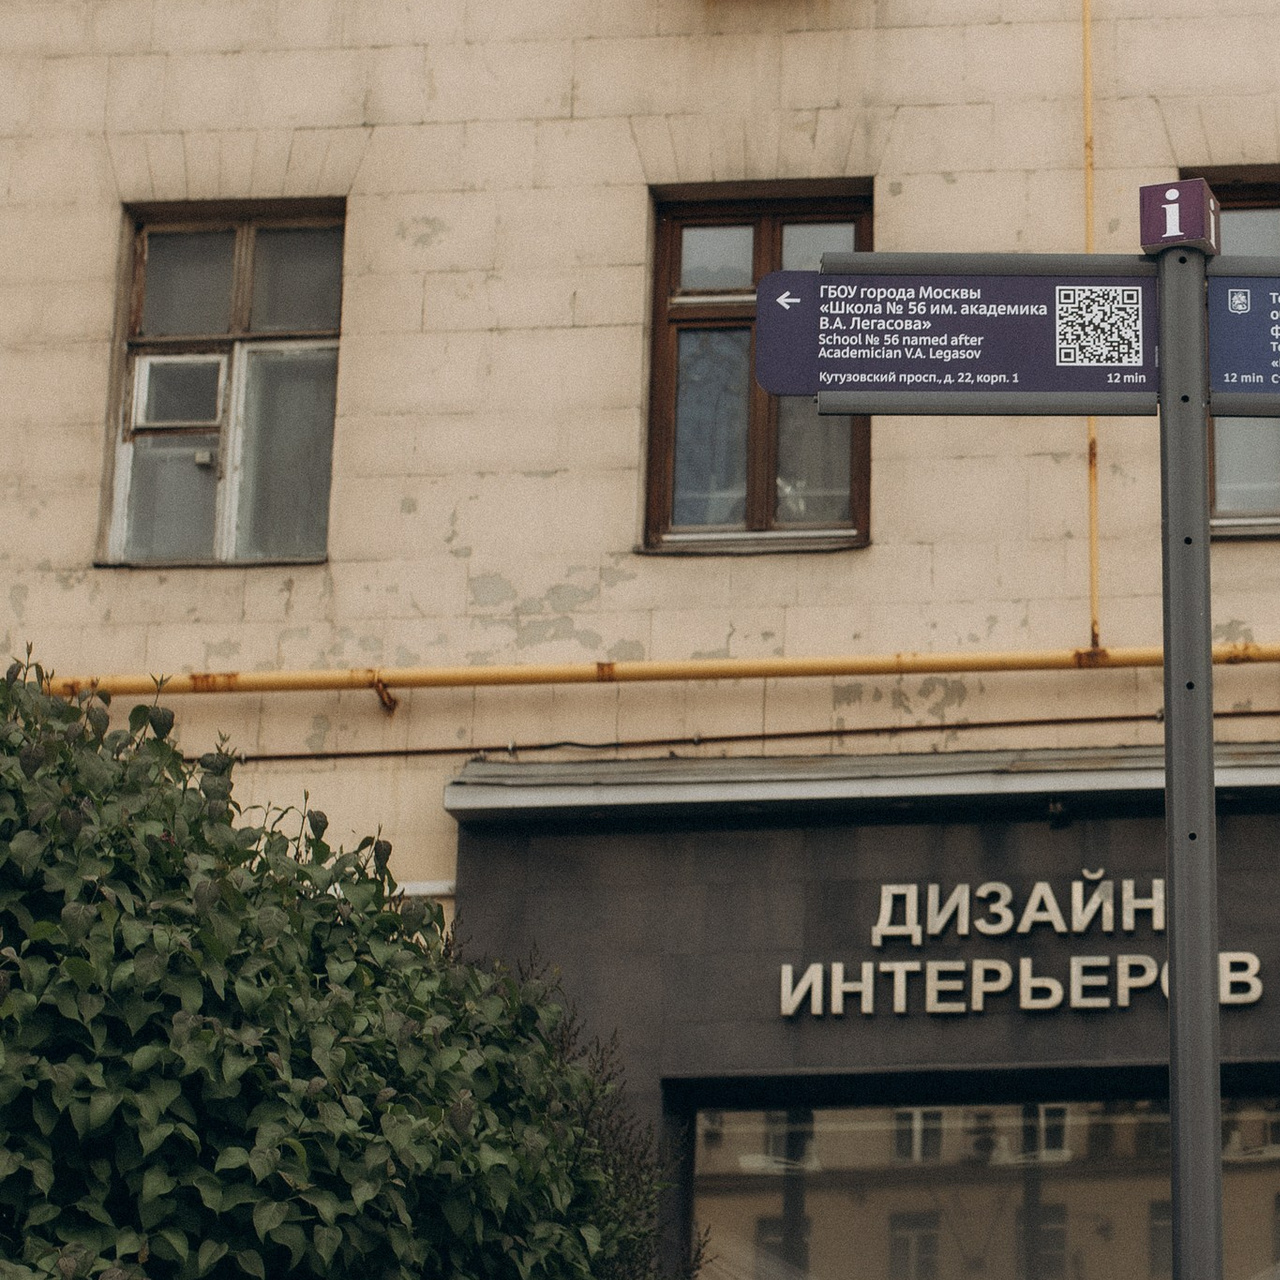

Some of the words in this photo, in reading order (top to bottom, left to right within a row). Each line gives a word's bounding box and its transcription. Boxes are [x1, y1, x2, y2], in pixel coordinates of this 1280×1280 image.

[821, 285, 857, 298] ГБОУ
[861, 288, 915, 301] города
[919, 286, 980, 299] Москвы
[820, 301, 882, 314] «Школа
[887, 302, 903, 314] №
[909, 302, 926, 314] 56
[931, 305, 956, 314] им.
[961, 304, 1047, 316] академика
[820, 317, 846, 329] В.А.
[850, 317, 931, 330] Легасова»
[819, 333, 862, 345] School
[866, 334, 879, 345] №
[884, 334, 899, 345] 56
[903, 334, 947, 345] named
[951, 334, 983, 345] after
[819, 347, 901, 358] Academician
[905, 348, 925, 358] V.A.
[930, 348, 981, 361] Legasov
[820, 372, 896, 384] Кутузовский
[899, 374, 941, 384] просп.,
[944, 374, 954, 384] д.
[958, 373, 974, 383] 22,
[977, 375, 1009, 384] корп.
[1013, 373, 1018, 382] 1
[1108, 373, 1120, 383] 12
[1124, 373, 1146, 382] min
[1225, 373, 1237, 382] 12
[1241, 373, 1263, 382] min
[872, 868, 1165, 947] ДИЗАЙН
[780, 951, 1263, 1015] ИНТЕРЬЕРВ
